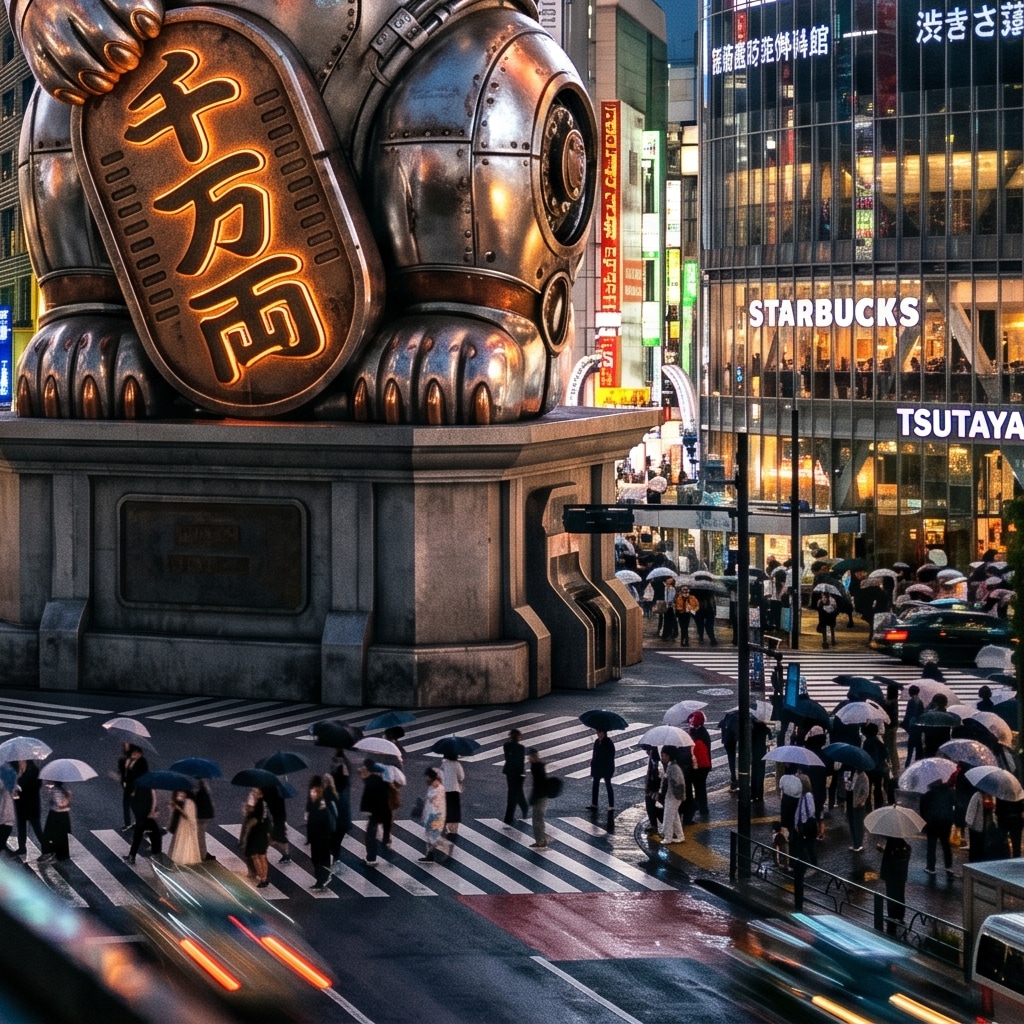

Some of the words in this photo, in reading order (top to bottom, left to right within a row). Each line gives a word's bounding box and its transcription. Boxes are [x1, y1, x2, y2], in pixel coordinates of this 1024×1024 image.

[124, 48, 327, 386] 千万両
[748, 296, 921, 328] STARBUCKS
[896, 407, 1024, 441] TSUTAYA
